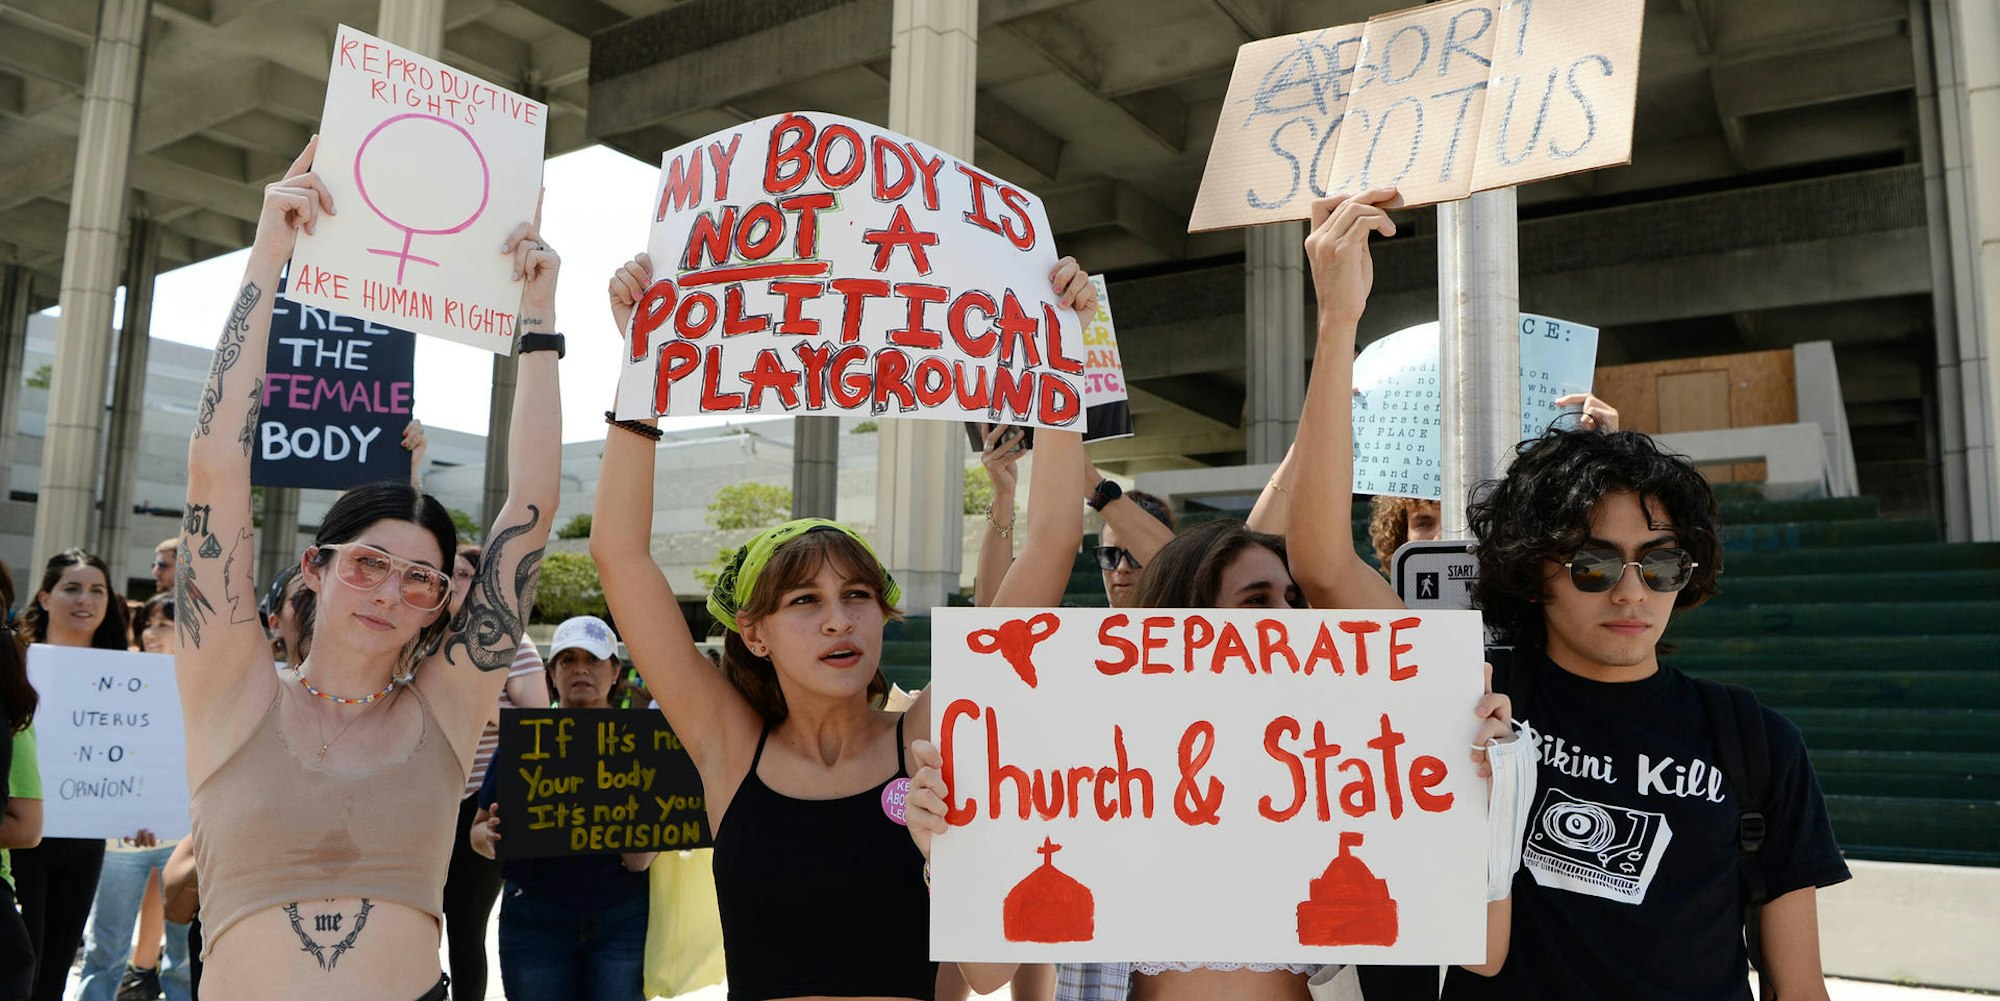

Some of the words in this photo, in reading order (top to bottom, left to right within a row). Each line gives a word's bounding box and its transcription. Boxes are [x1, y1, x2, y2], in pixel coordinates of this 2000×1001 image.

[341, 35, 539, 126] REPRODUCTIVE
[1237, 0, 1533, 128] ABORT
[371, 78, 478, 126] RIGHTS
[1246, 54, 1615, 210] SCOTUS
[656, 133, 743, 222] MY
[763, 115, 945, 212] BODY
[954, 161, 1036, 252] IS
[678, 193, 844, 270] NOT
[862, 204, 940, 277] A
[295, 264, 349, 300] ARE
[363, 280, 433, 320] HUMAN
[445, 298, 516, 337] RIGHTS
[630, 278, 1084, 376] POLITICAL
[279, 338, 372, 370] THE
[262, 373, 412, 414] FEMALE
[652, 339, 1080, 427] PLAYGROUND
[1352, 414, 1441, 426] nderstan
[1377, 427, 1428, 439] PLACE
[261, 421, 382, 463] BODY
[1380, 470, 1408, 479] and
[1388, 482, 1419, 494] HER
[1448, 565, 1474, 577] START
[1095, 614, 1422, 681] SEPARATE
[72, 711, 150, 727] UTERUS
[519, 717, 575, 759] If
[598, 721, 636, 756] It's
[519, 765, 584, 802] Your
[598, 759, 656, 792] body
[940, 699, 1154, 827] Church
[1174, 720, 1225, 825] &
[1258, 713, 1454, 822] State
[1637, 754, 1725, 803] Kill
[527, 802, 586, 830] It's
[594, 794, 639, 822] not
[655, 794, 706, 822] you
[886, 789, 906, 807] ABO
[571, 821, 700, 849] DECISION
[315, 912, 343, 931] me
